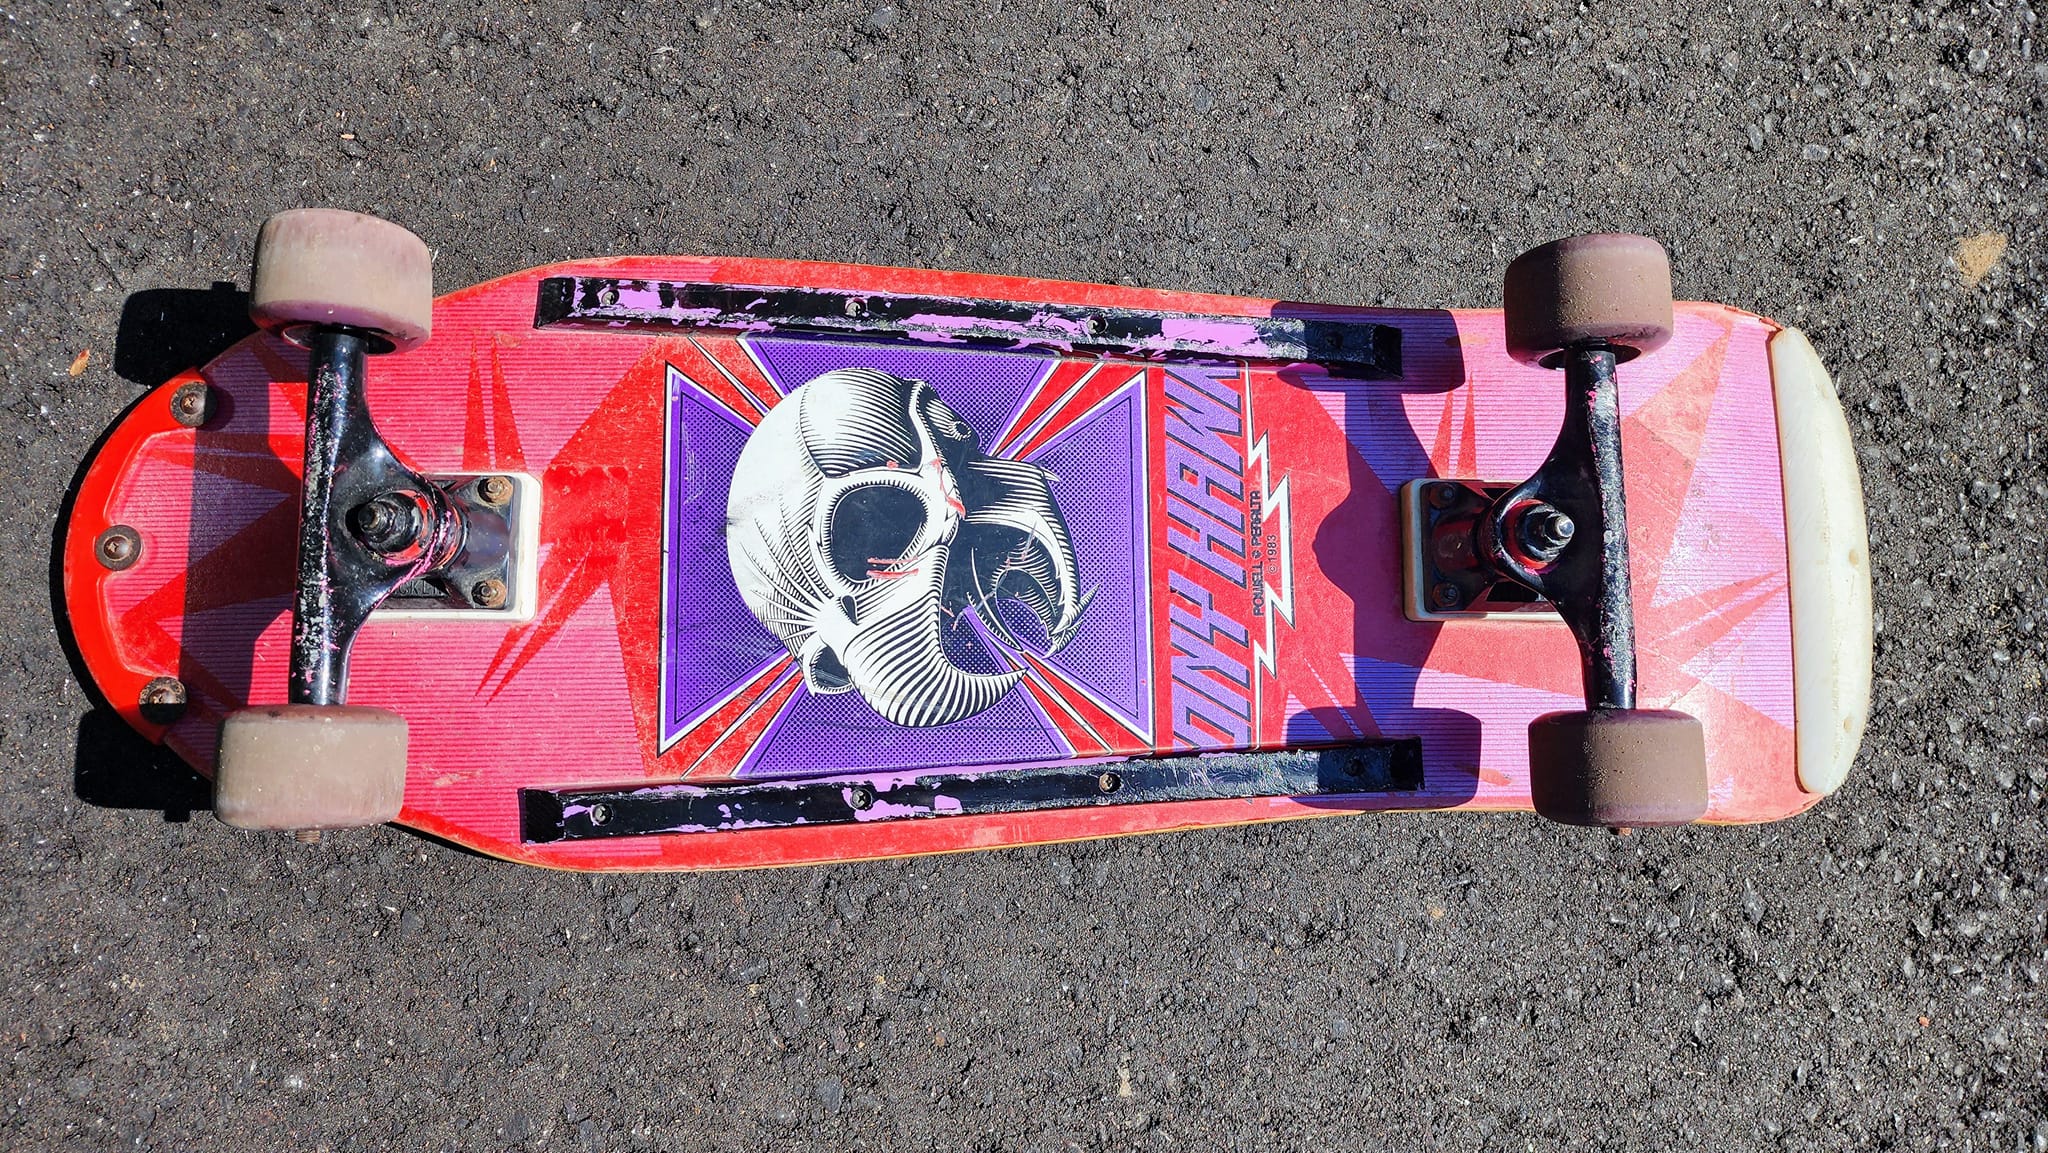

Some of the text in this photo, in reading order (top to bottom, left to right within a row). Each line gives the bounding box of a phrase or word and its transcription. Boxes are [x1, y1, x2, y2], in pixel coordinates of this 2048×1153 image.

[1250, 490, 1264, 616] POWELL PERALTA
[1169, 568, 1251, 752] ONY
